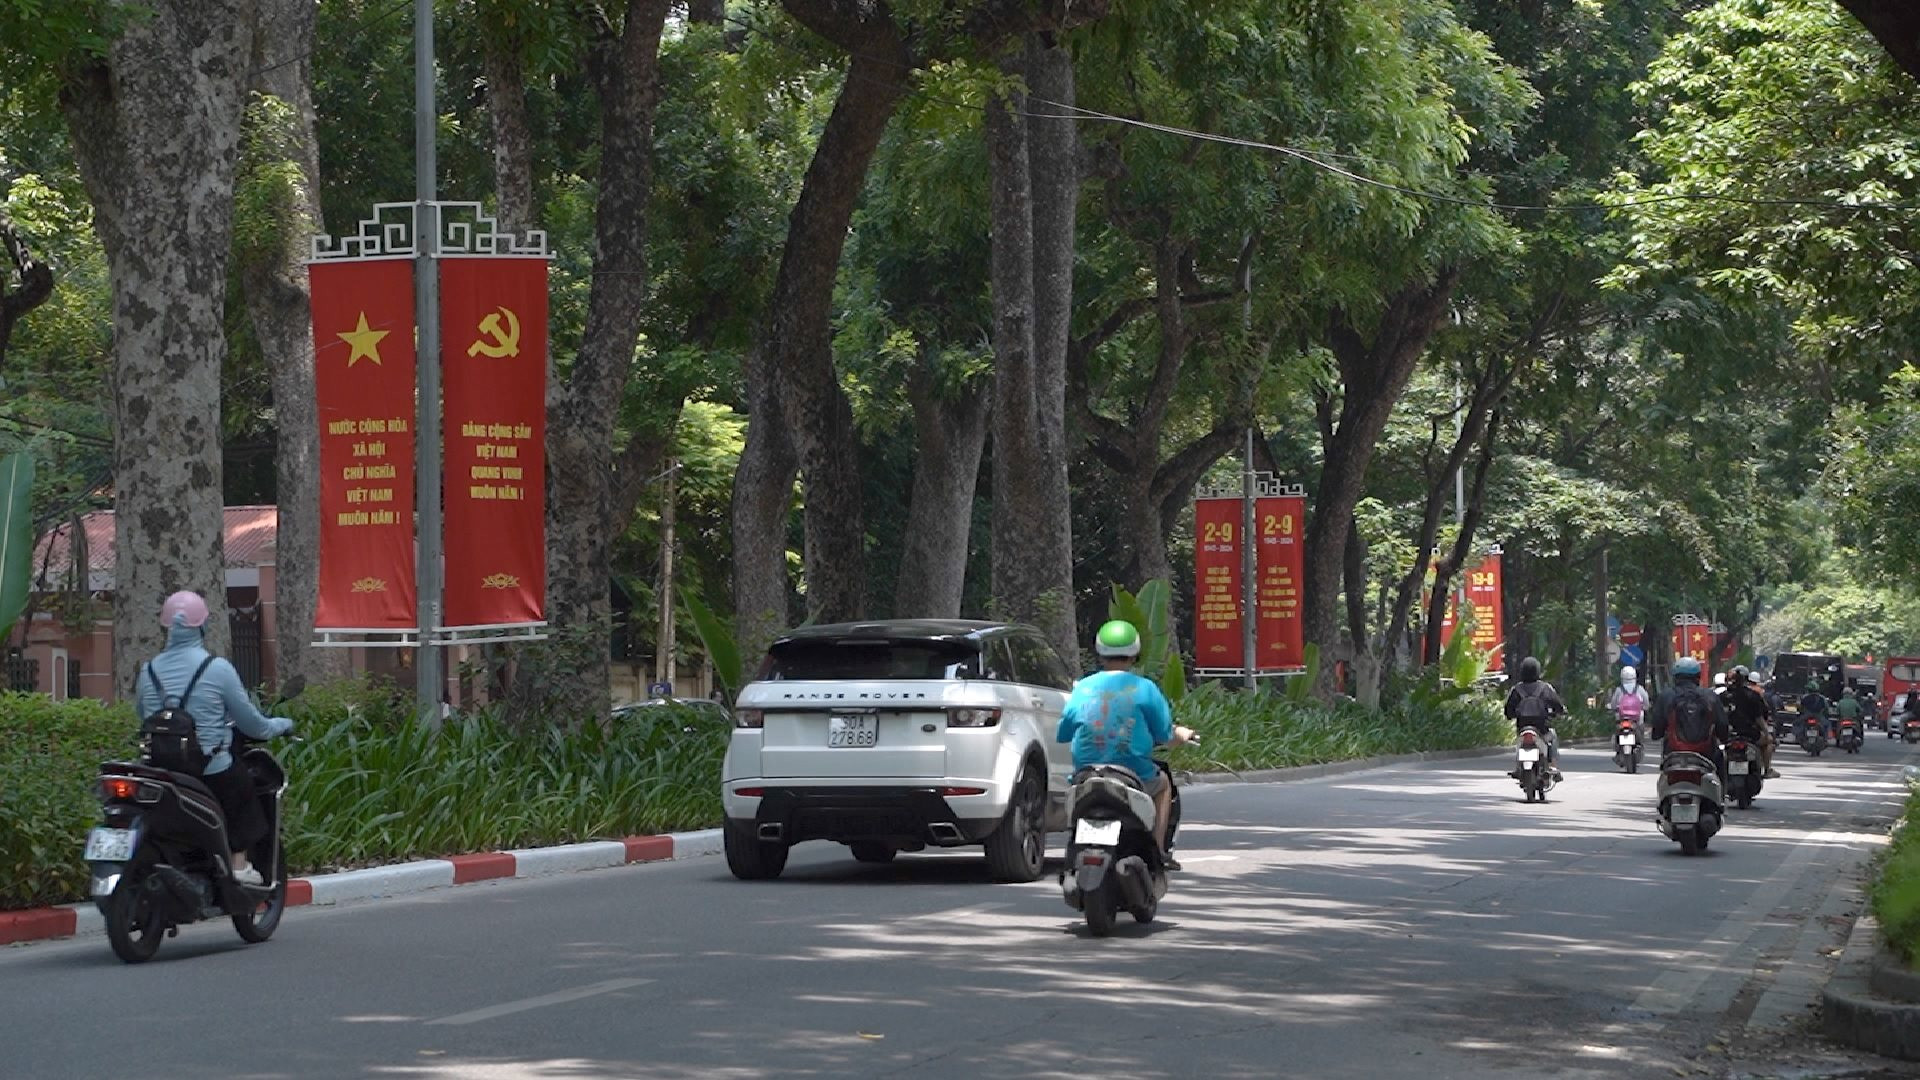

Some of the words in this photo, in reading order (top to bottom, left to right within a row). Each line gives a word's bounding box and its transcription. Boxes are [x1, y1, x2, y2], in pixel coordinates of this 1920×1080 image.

[328, 418, 356, 434] NƯỚC
[359, 418, 386, 436] CỘNG
[388, 416, 408, 432] HÒA
[488, 422, 512, 440] CỘNG
[352, 441, 367, 456] XÃ
[369, 440, 386, 458] HỘI
[476, 442, 496, 460] VIỆT
[496, 446, 517, 458] NAM
[343, 463, 364, 480] CHỦ
[366, 464, 396, 479] NGHĨA
[471, 466, 500, 480] QUANG
[346, 487, 368, 505] VIỆT
[370, 489, 392, 501] NAM
[470, 484, 496, 499] MUÔN
[498, 485, 518, 500] NĂM
[338, 510, 368, 526] MUÔN
[371, 509, 393, 525] NĂM
[1264, 515, 1293, 535] 2-9
[1204, 522, 1232, 542] 2-9
[840, 716, 864, 730] 30A
[832, 730, 873, 745] 278.68
